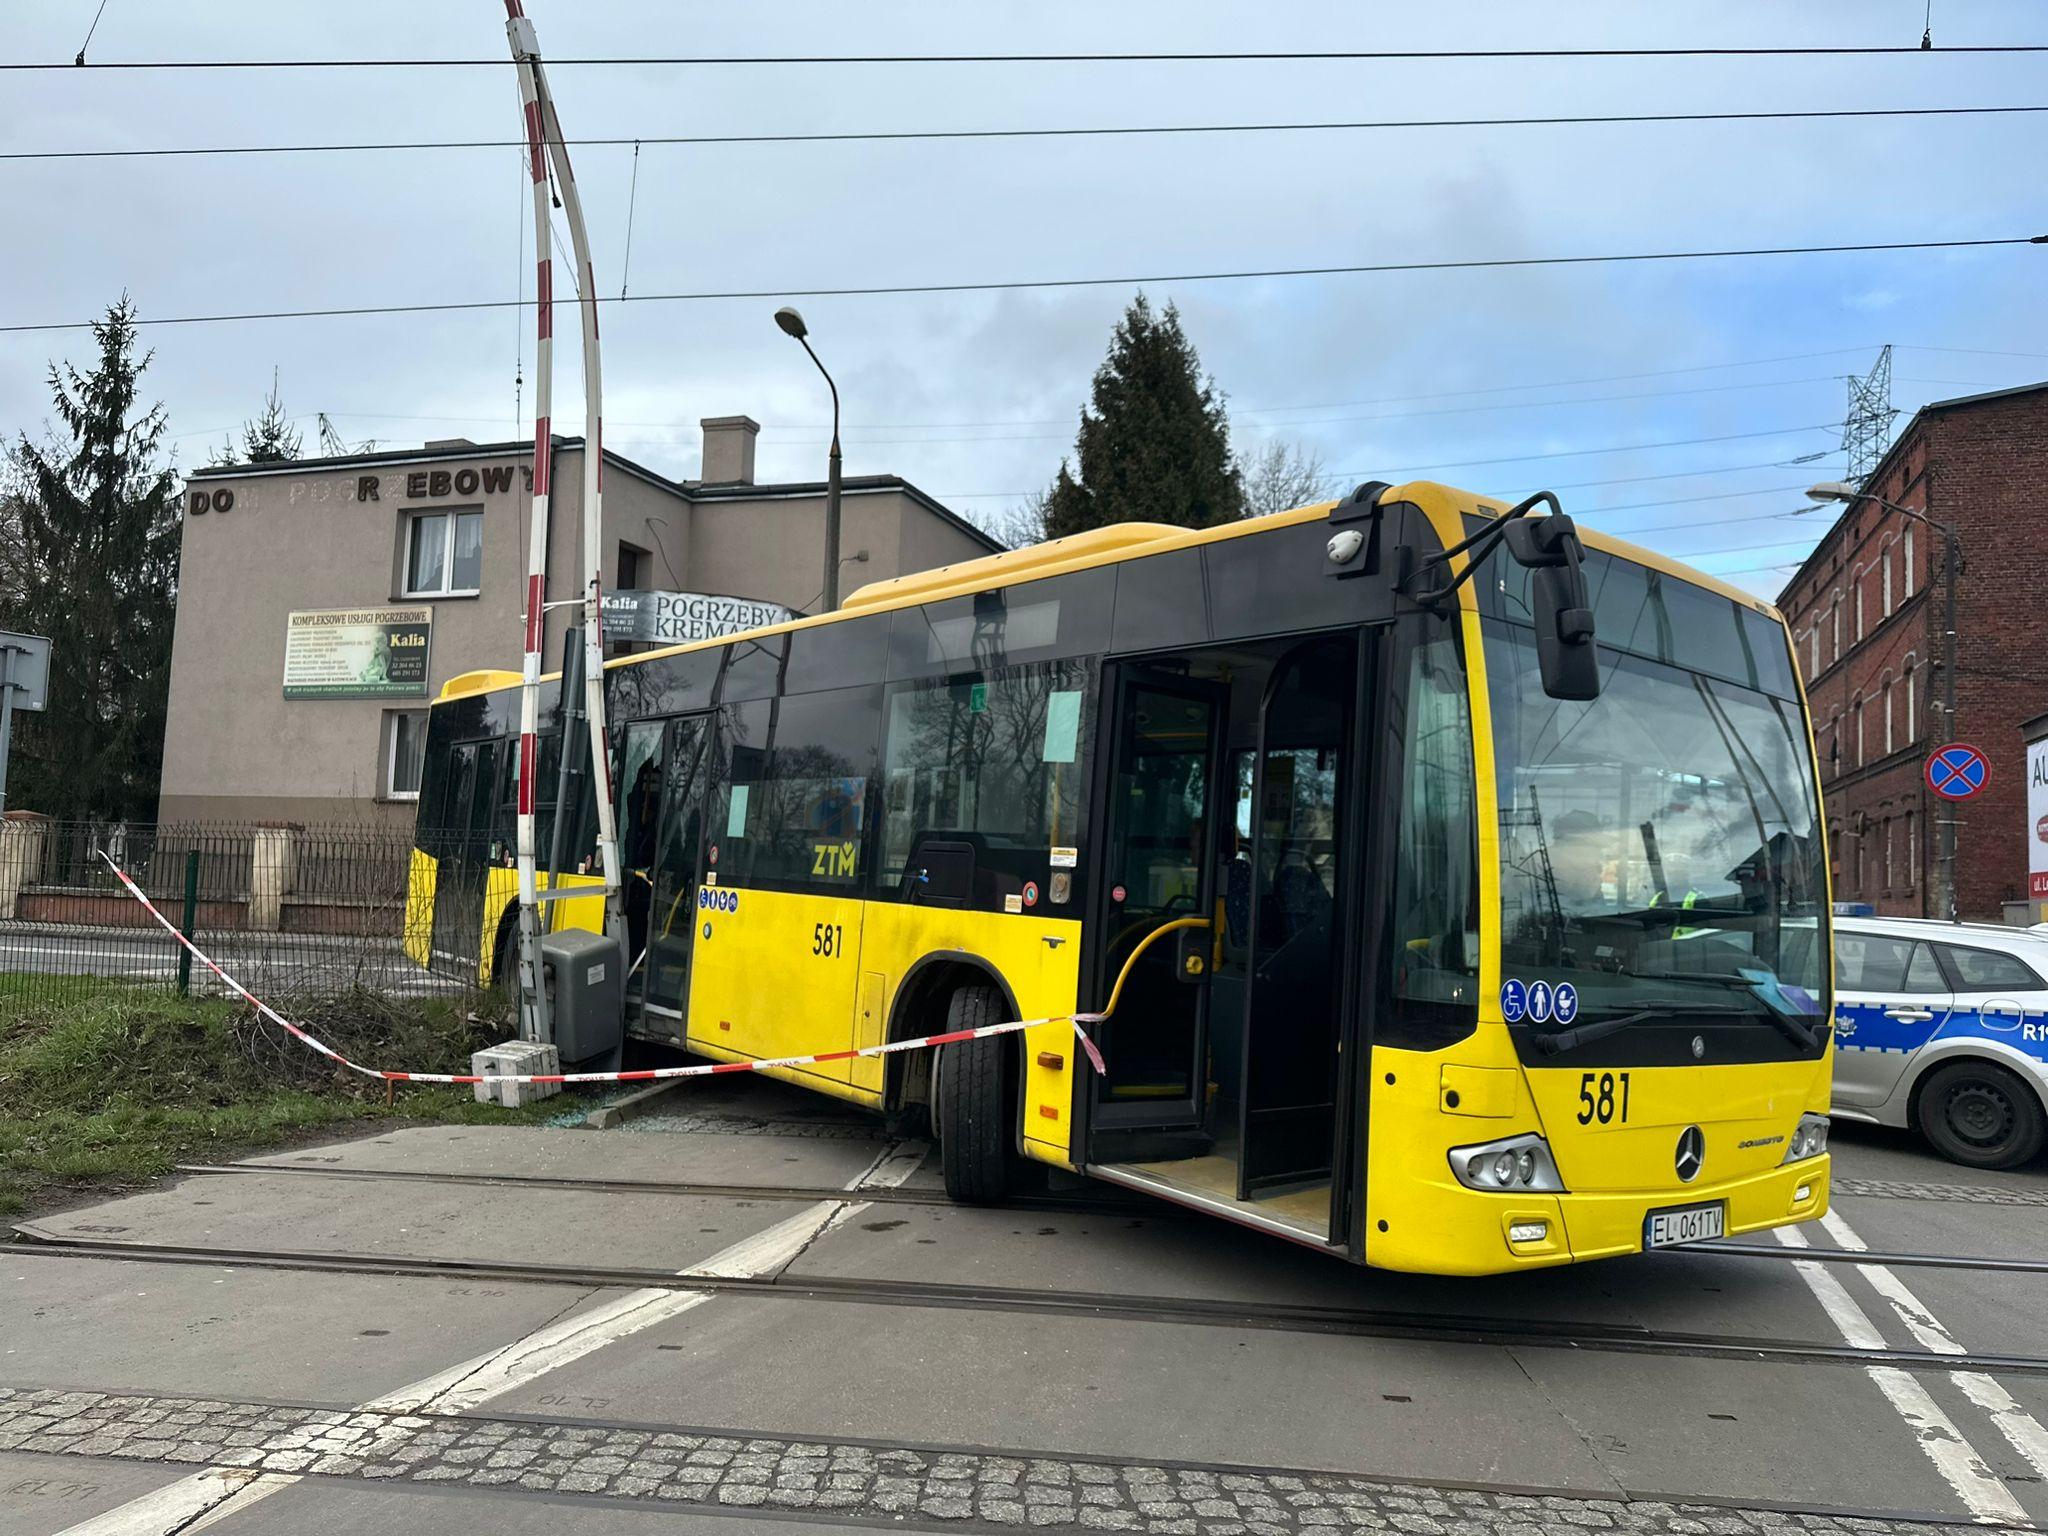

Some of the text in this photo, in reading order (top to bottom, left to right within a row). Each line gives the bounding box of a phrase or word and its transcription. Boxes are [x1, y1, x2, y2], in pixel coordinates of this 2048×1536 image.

[292, 611, 427, 626] KOMPLEKSOWE USŁUGI POGRZEBOWE
[600, 596, 638, 610] Kalia
[656, 596, 777, 626] POGRZEBY
[390, 633, 426, 647] Kalia
[812, 841, 856, 877] ZTM
[813, 923, 842, 958] 581
[1577, 1072, 1629, 1125] 581
[1654, 1209, 1721, 1243] EL 061TV
